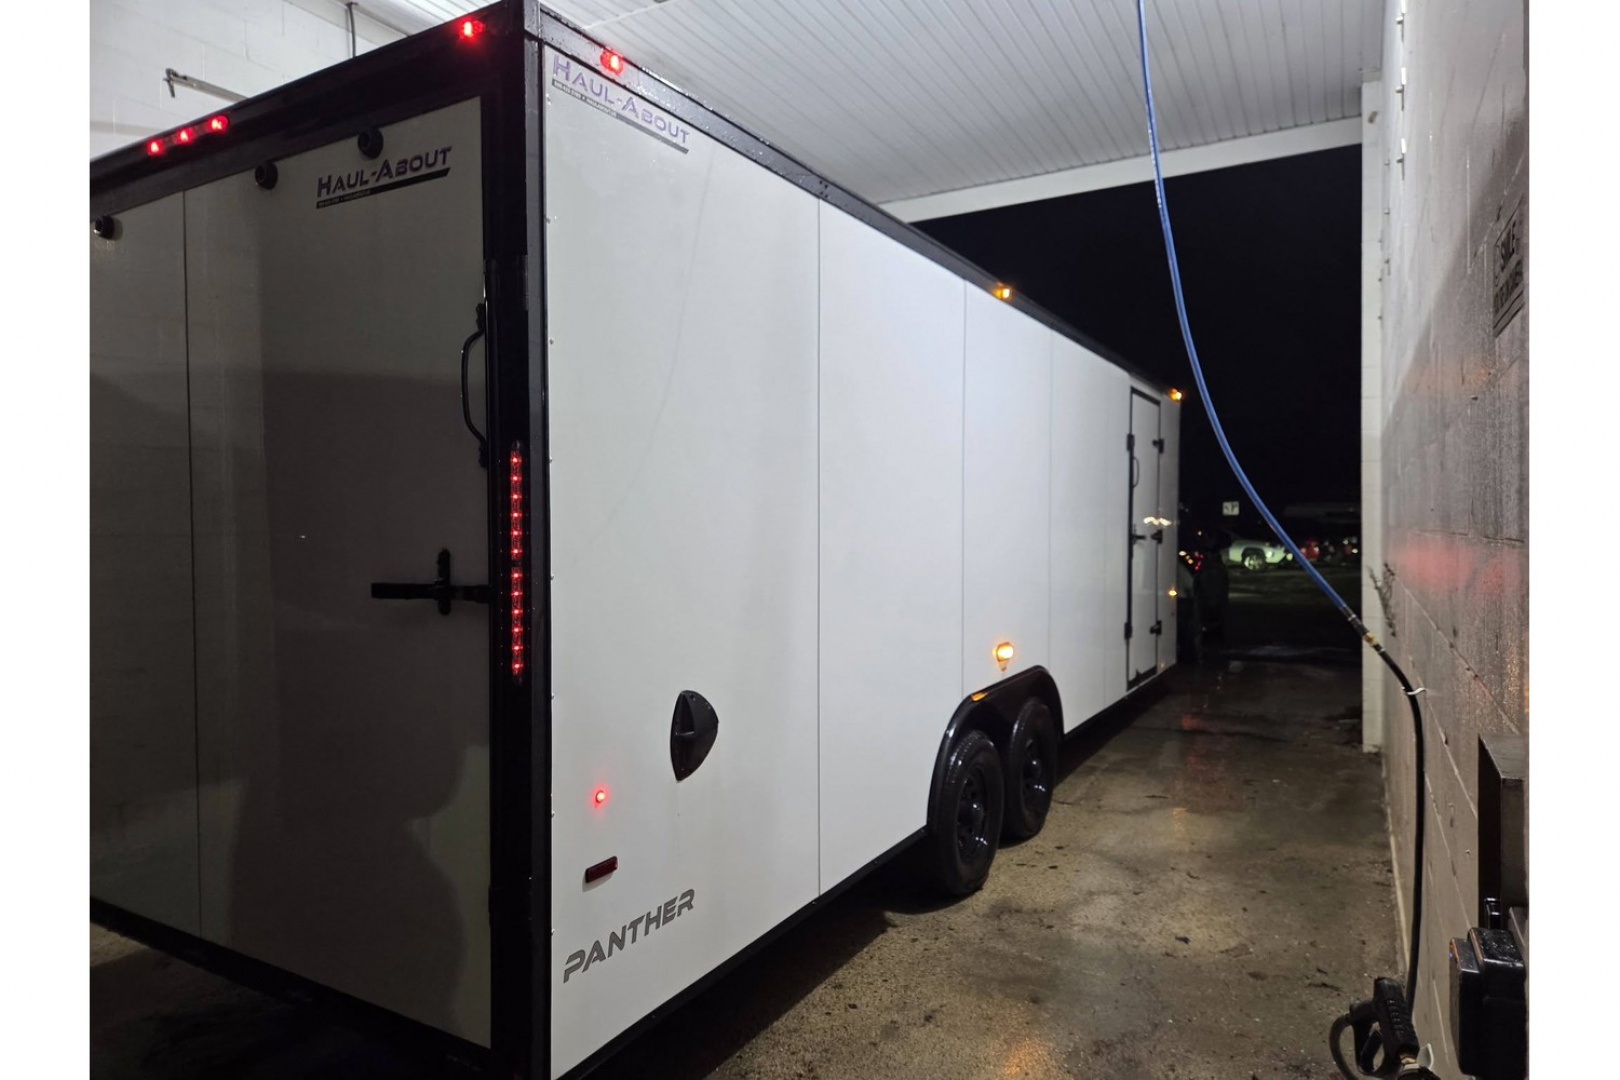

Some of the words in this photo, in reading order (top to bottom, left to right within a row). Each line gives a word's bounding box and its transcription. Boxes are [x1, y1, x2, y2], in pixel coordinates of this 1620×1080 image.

[553, 54, 689, 143] HAUL-ABOUT
[317, 146, 452, 197] HAUL-ABOUT
[563, 888, 695, 983] PANTHER
